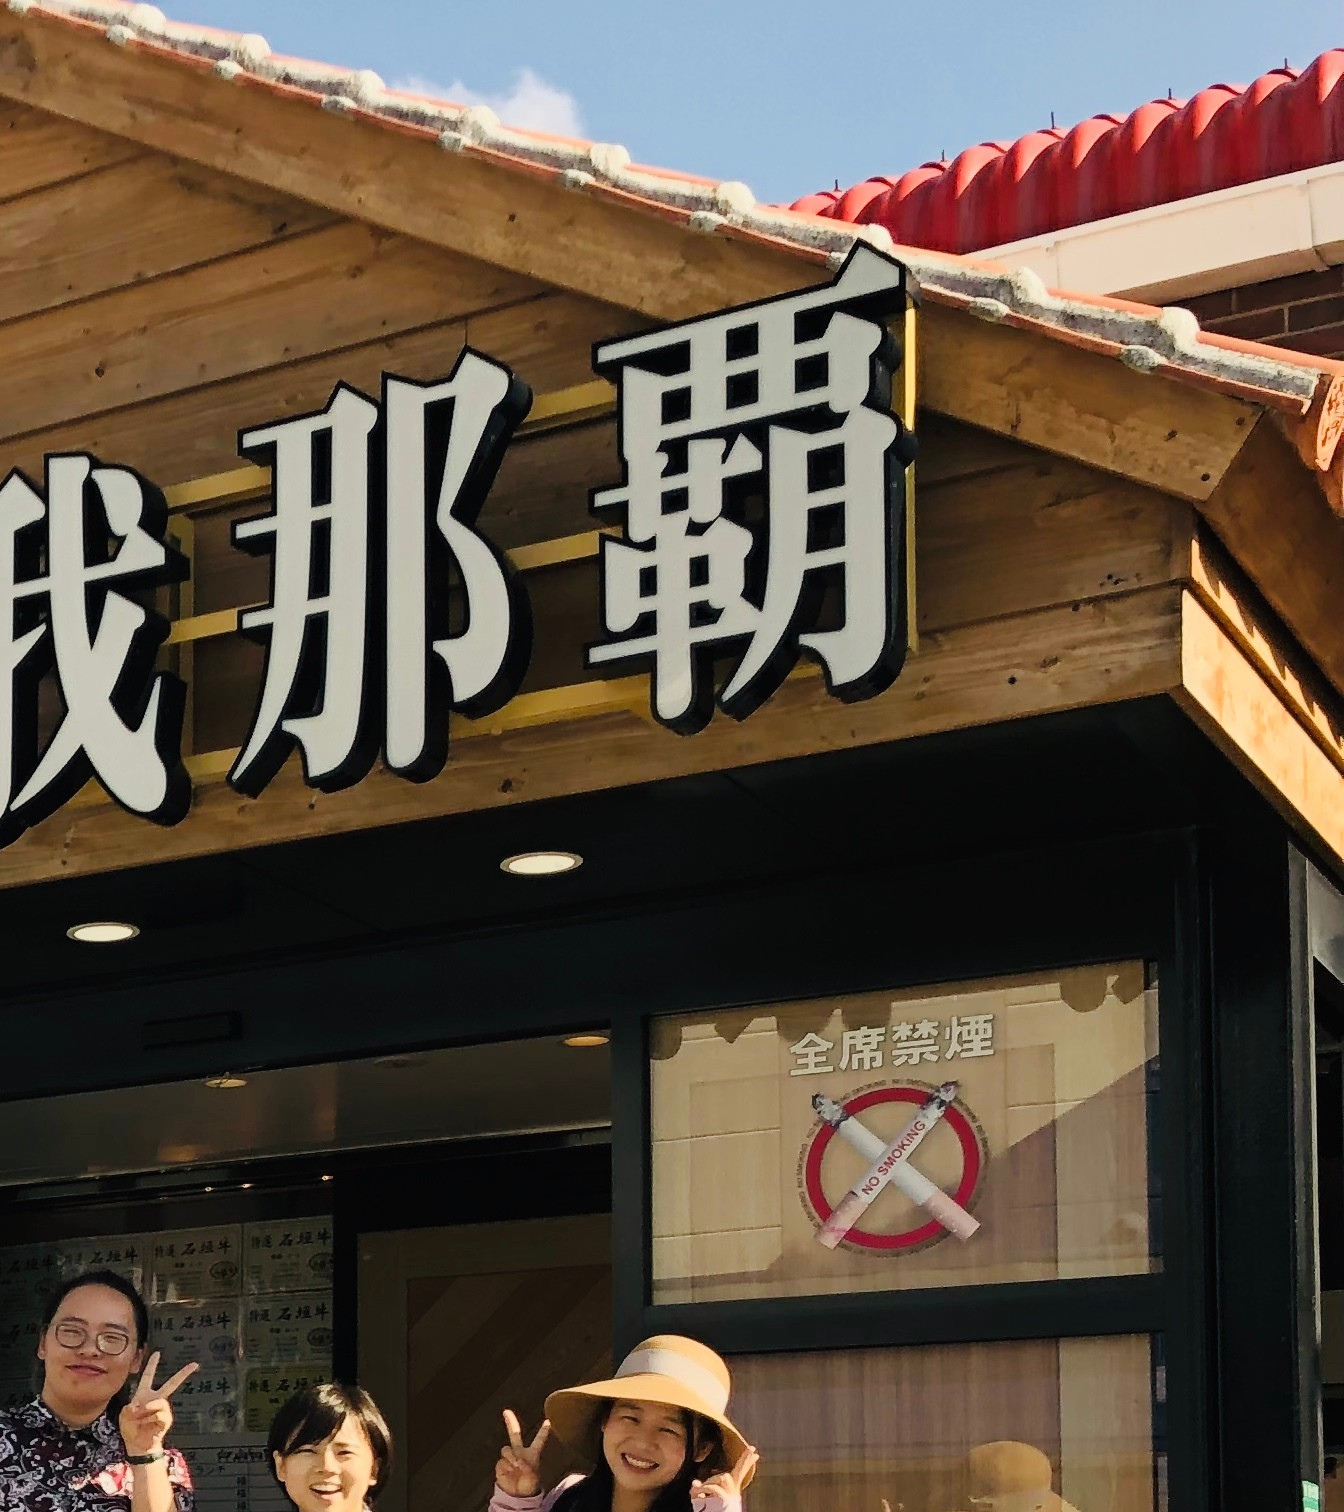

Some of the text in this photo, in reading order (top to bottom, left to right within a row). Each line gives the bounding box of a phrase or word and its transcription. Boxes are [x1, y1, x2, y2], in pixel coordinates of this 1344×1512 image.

[789, 1013, 996, 1077] 全席禁煙
[861, 1120, 926, 1196] NO SMOKING
